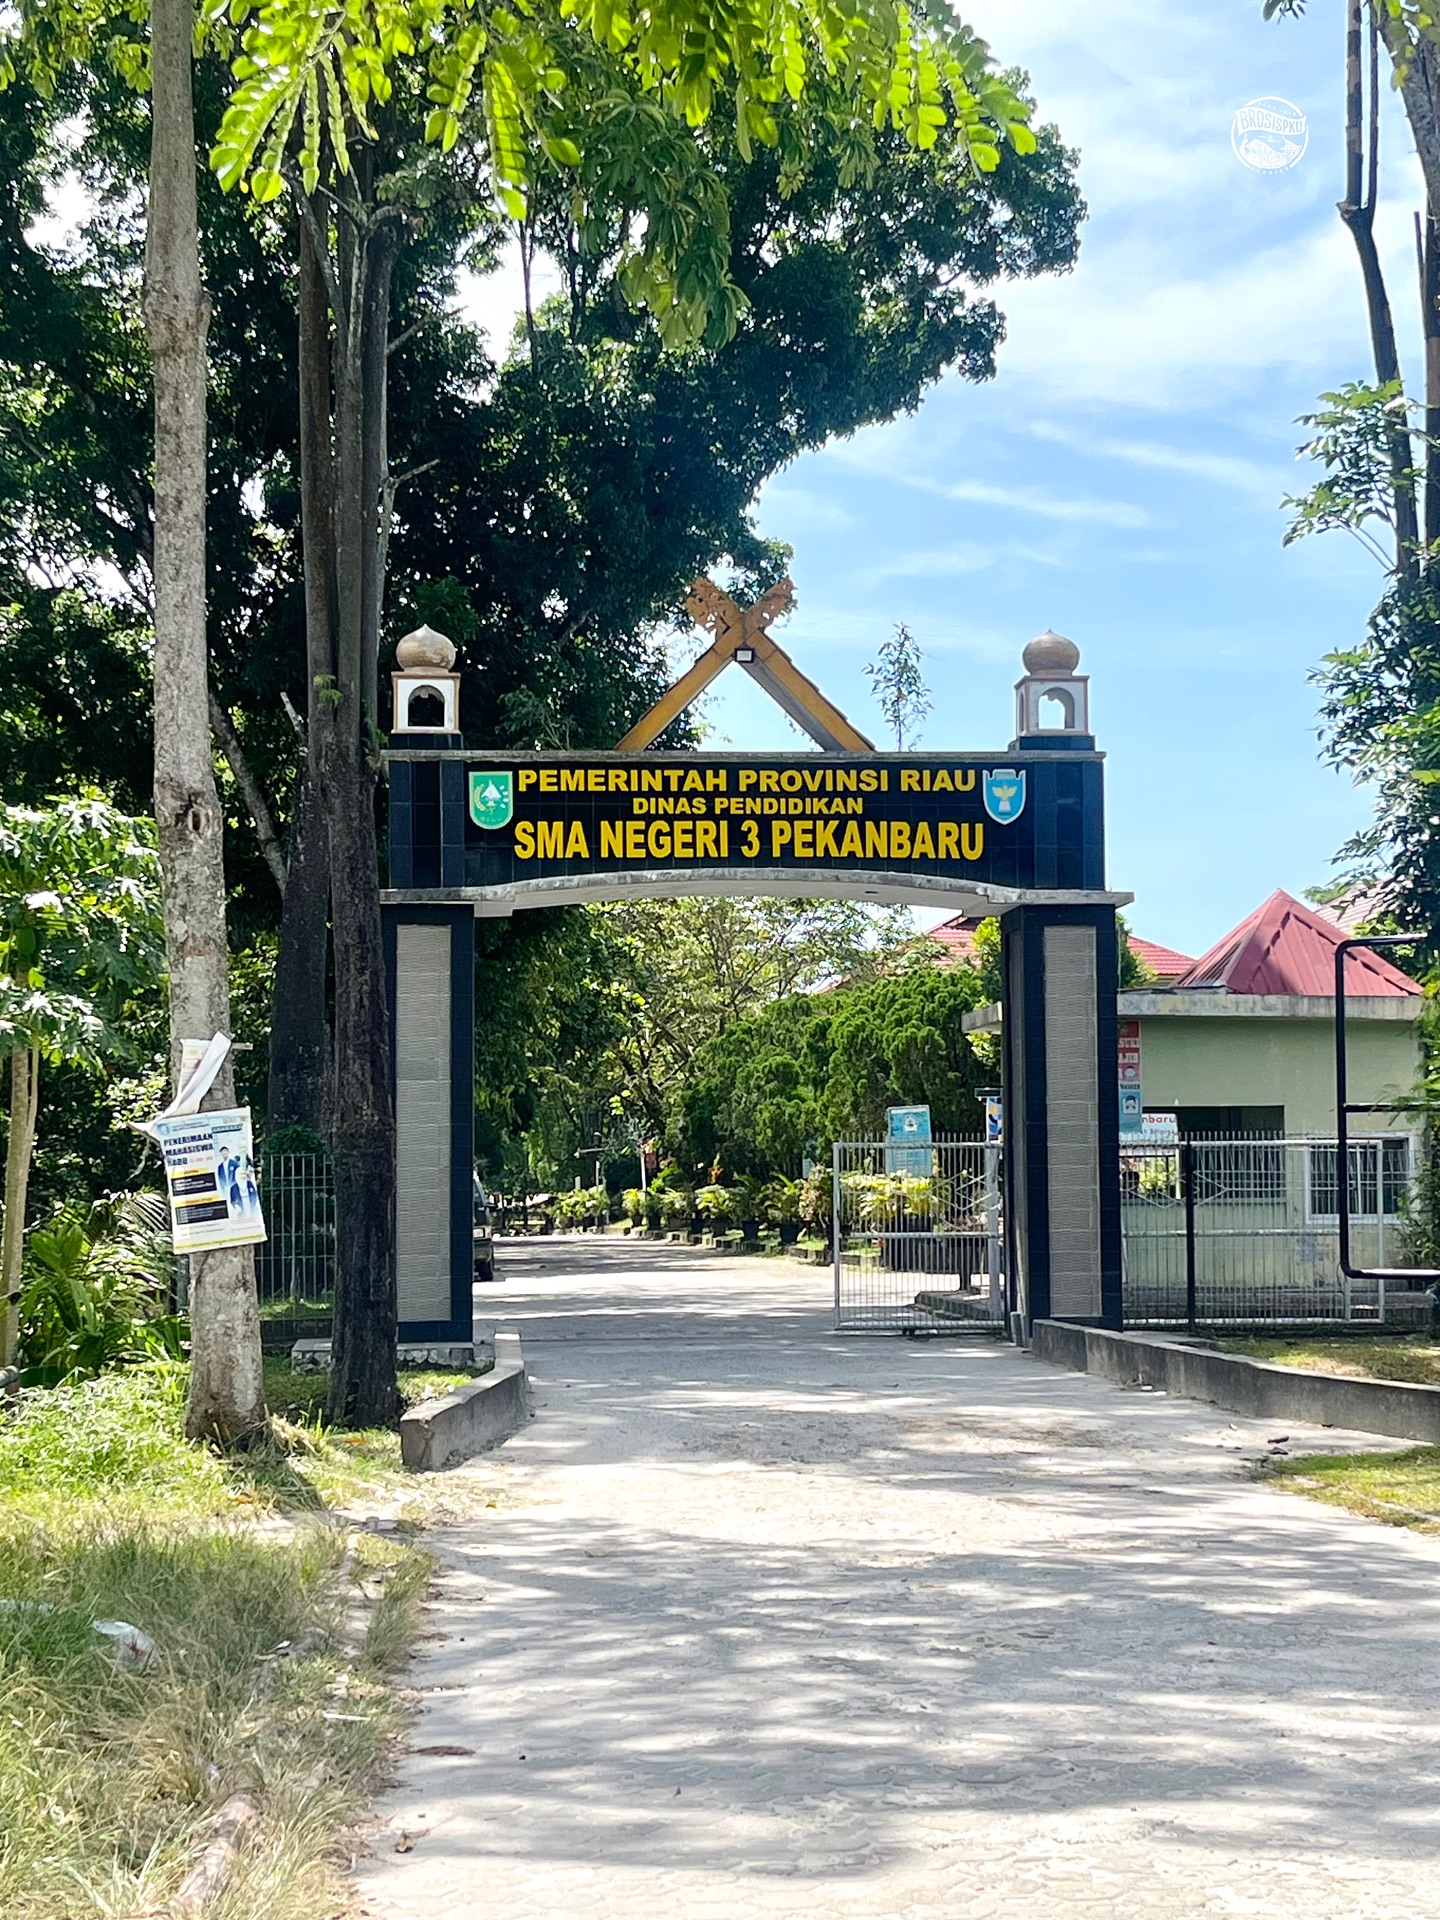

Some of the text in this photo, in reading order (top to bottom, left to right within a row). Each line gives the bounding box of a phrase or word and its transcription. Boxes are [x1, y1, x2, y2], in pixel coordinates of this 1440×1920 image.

[518, 769, 976, 792] PEMERINTAH PROVINSI RIAU
[632, 797, 864, 815] DINAS PENDIDIKAN
[513, 819, 984, 860] SMA NEGERI 3 PEKANBARU
[165, 1143, 214, 1156] MAHASISWA
